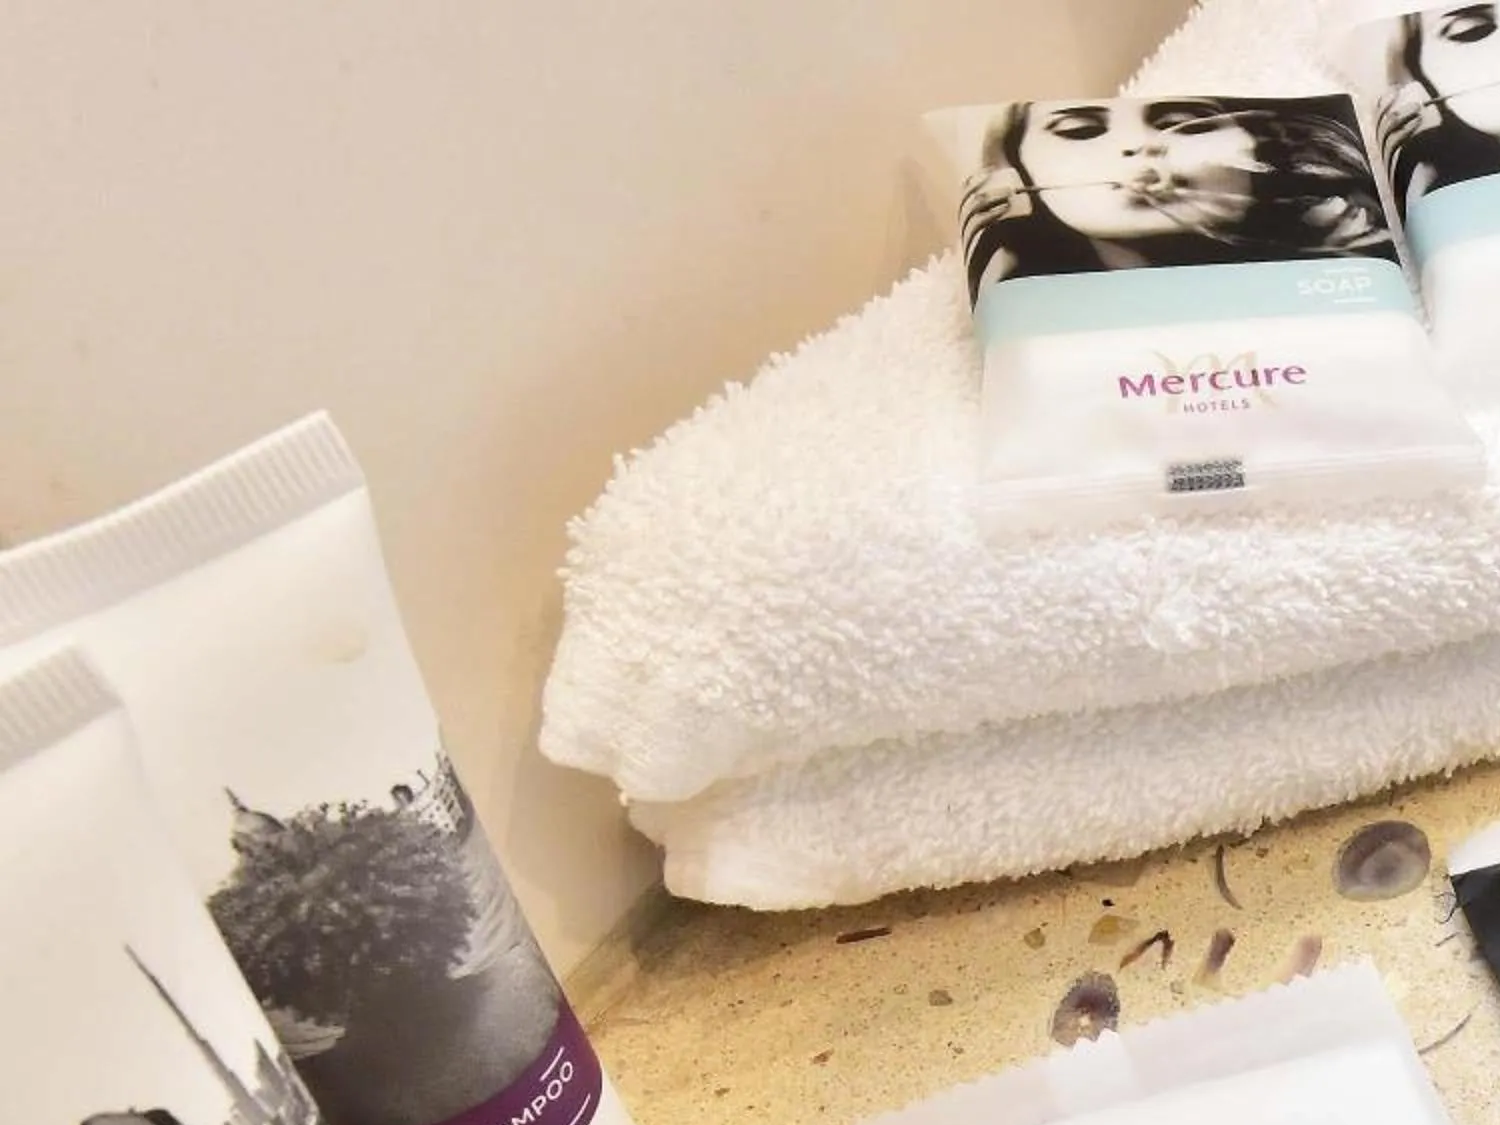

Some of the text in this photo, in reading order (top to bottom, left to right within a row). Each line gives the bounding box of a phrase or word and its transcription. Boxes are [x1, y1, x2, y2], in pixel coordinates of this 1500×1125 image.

[1297, 276, 1372, 297] SOAP
[1118, 361, 1308, 399] Mercure
[1183, 398, 1251, 414] HOTELS
